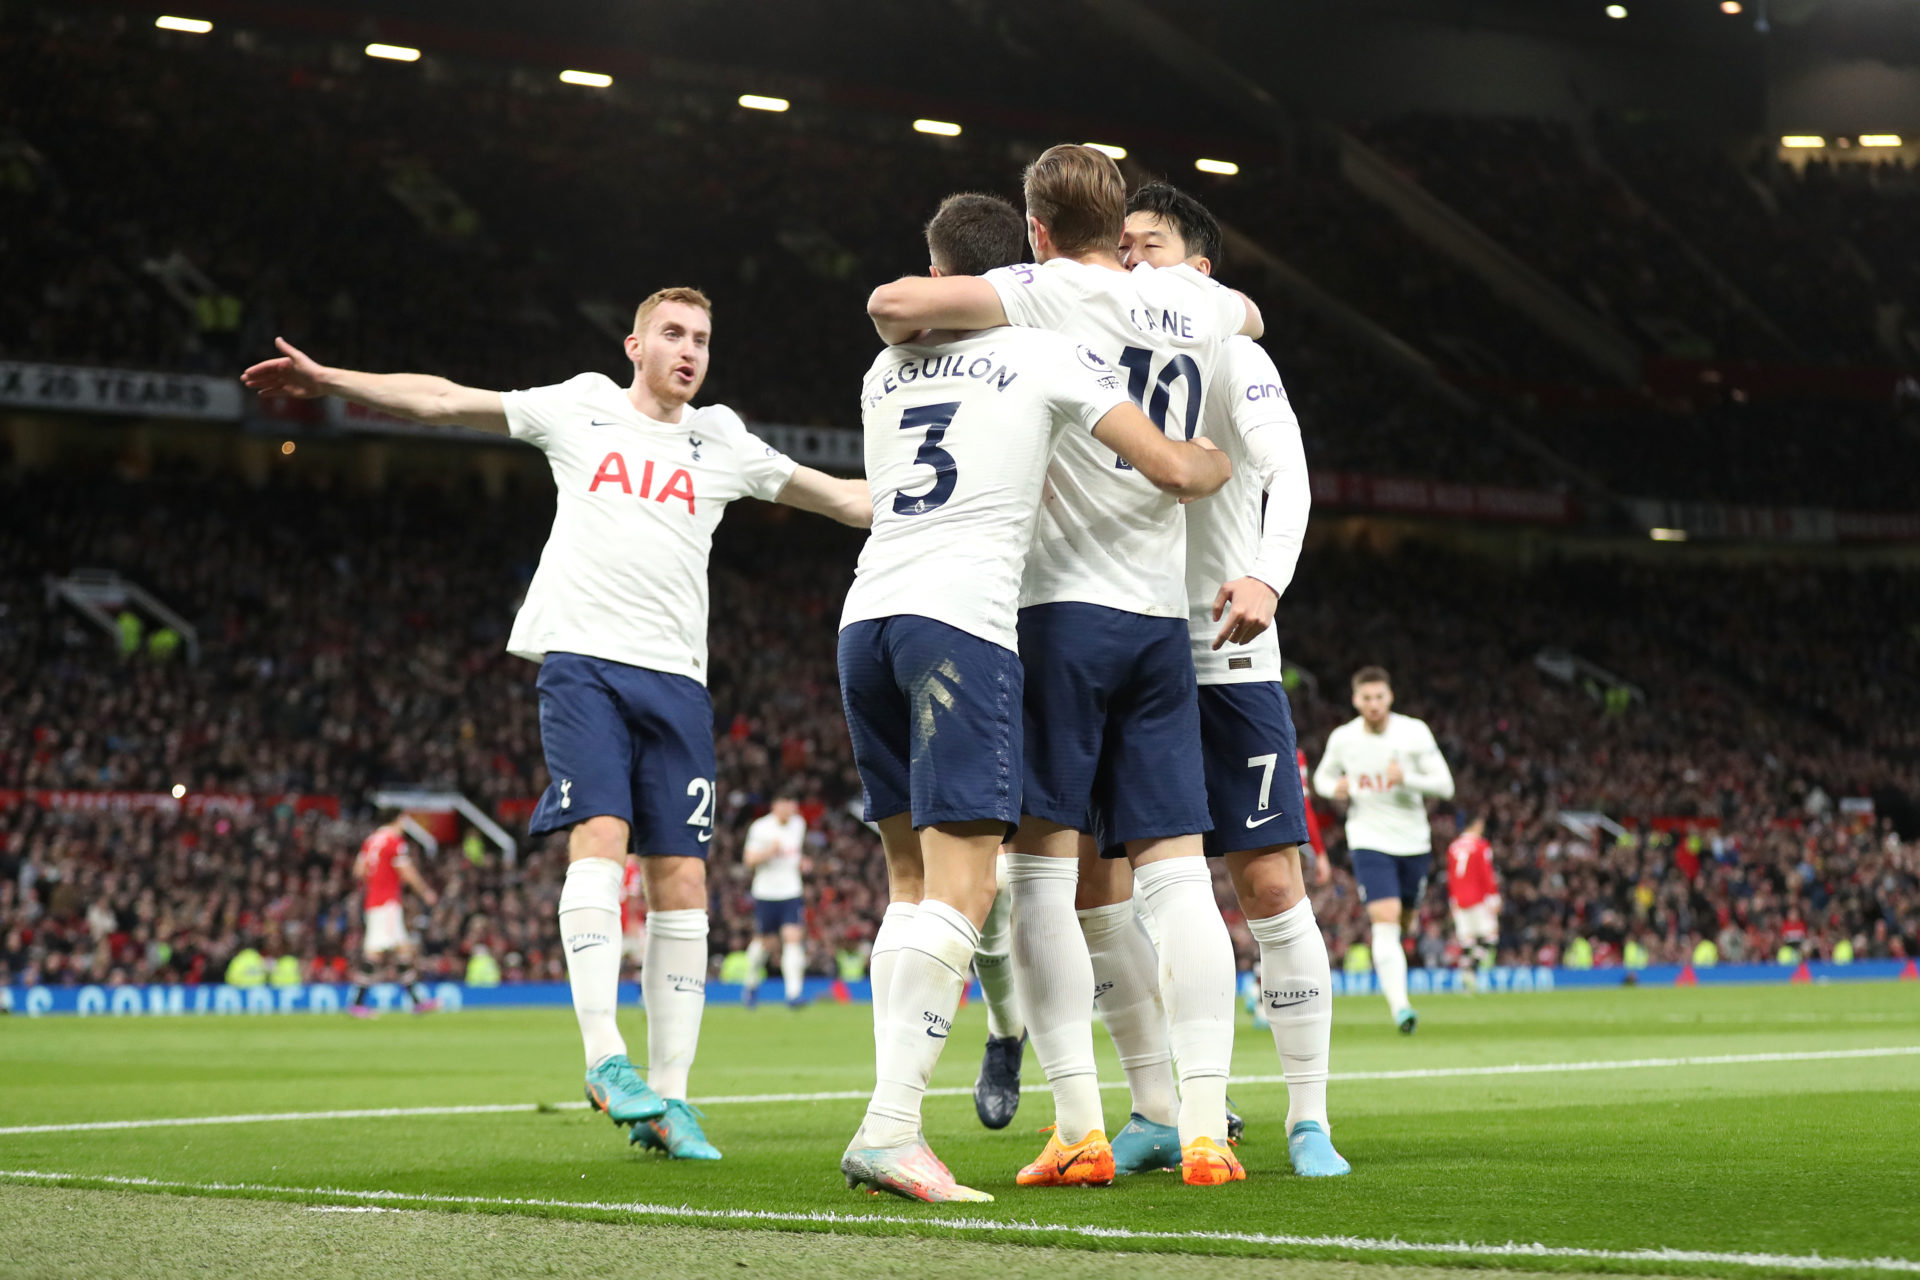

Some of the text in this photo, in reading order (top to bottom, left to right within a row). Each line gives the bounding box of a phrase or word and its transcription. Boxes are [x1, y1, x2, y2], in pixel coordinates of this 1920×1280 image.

[588, 451, 696, 516] AIA
[892, 401, 962, 516] 3
[1247, 753, 1278, 811] 7
[1264, 987, 1319, 999] SPURS
